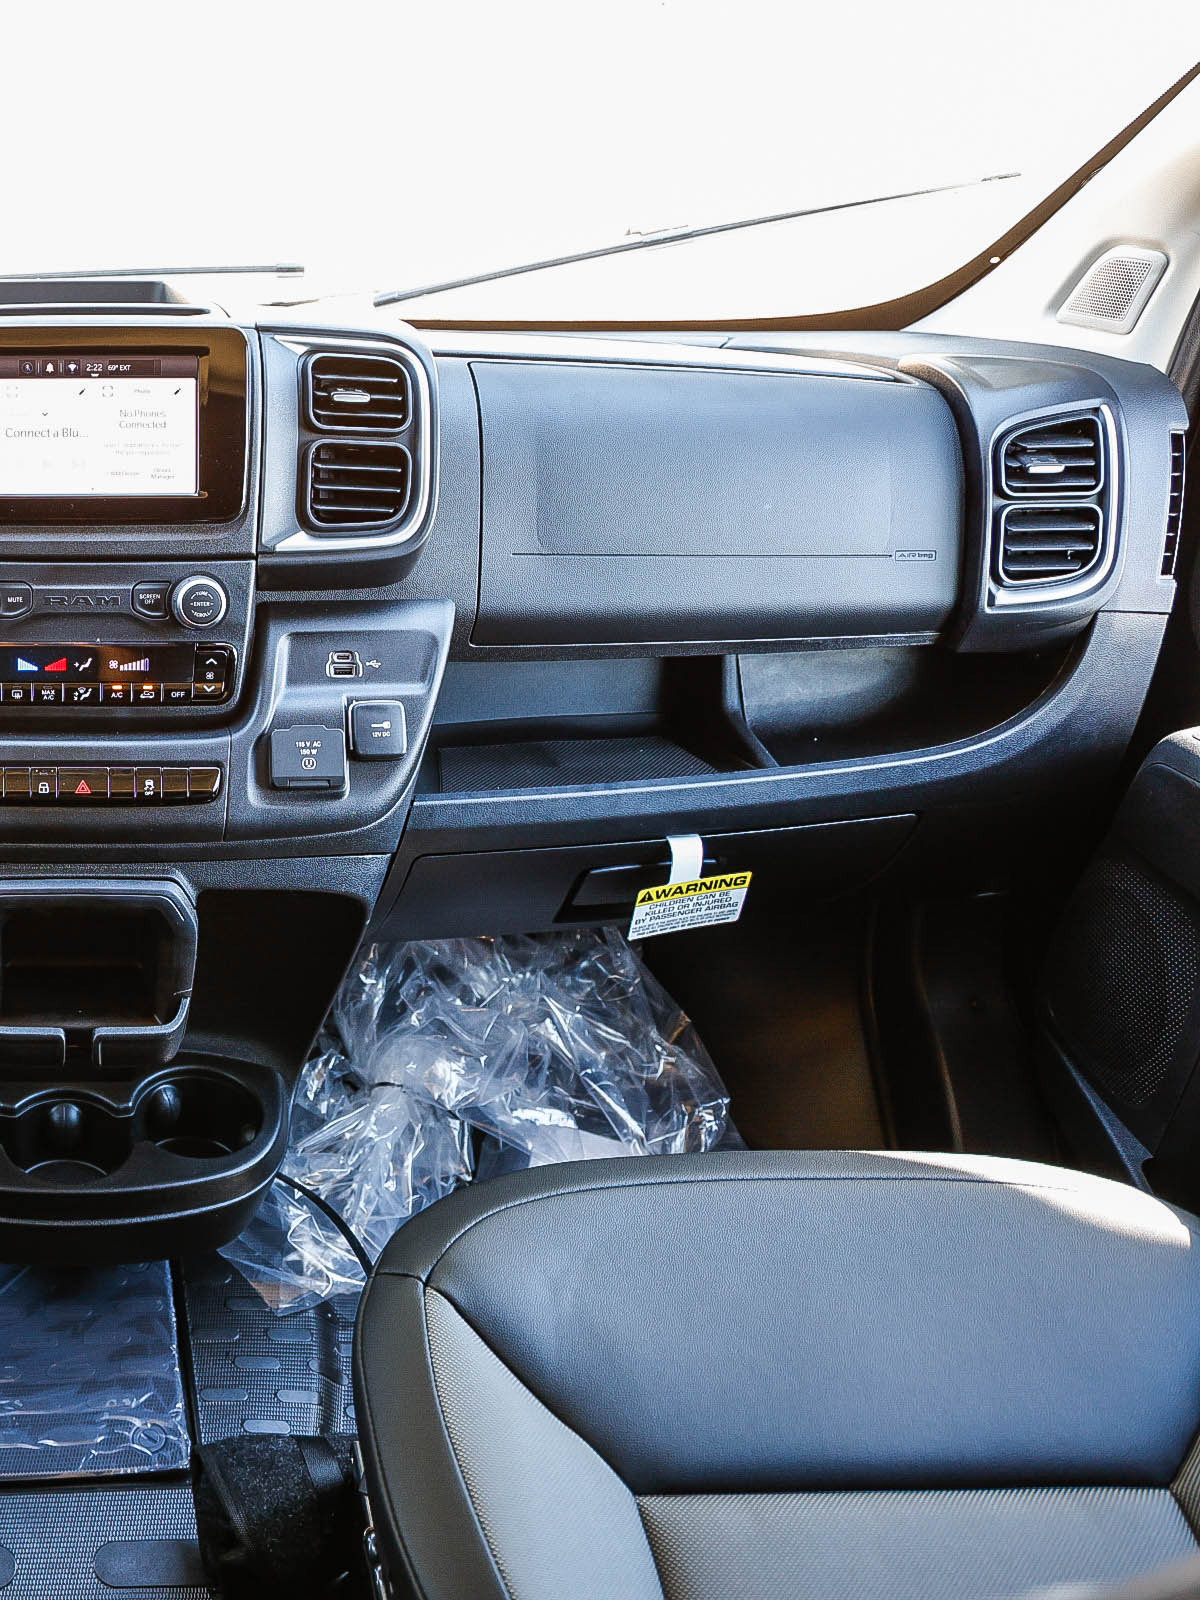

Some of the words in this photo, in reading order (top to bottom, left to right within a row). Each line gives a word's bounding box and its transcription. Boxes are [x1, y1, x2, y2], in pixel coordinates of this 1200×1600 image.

[86, 363, 103, 372] 2:22
[118, 419, 168, 429] Connected
[5, 427, 51, 439] Connect
[44, 595, 121, 606] RAM
[110, 690, 124, 699] A/C
[170, 690, 186, 699] OFF
[655, 876, 747, 899] WARNING
[644, 906, 675, 917] KILLED
[692, 896, 732, 908] INJURED
[649, 896, 693, 910] CHILDREN
[696, 893, 716, 901] CAN
[634, 918, 647, 926] BY
[649, 906, 703, 923] PASSENGER
[704, 901, 739, 912] AIRBAG
